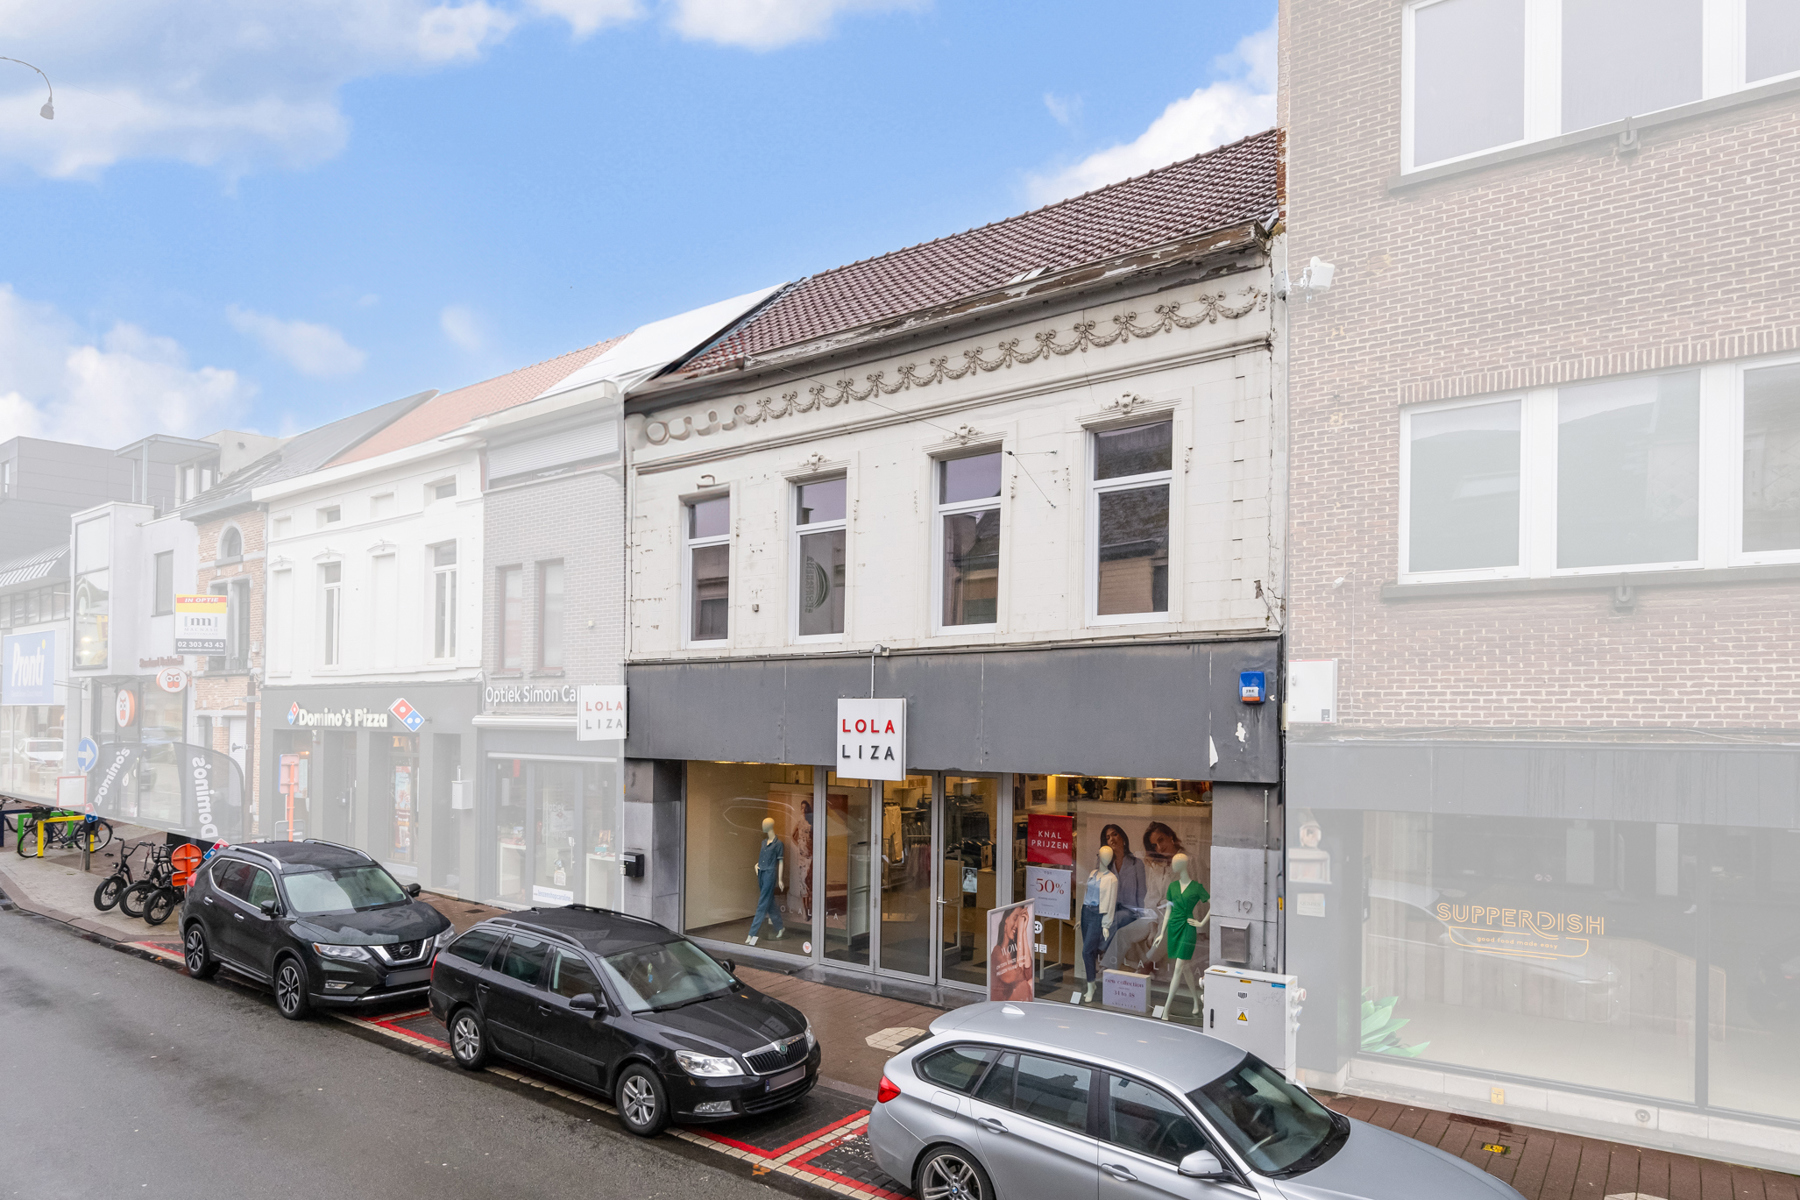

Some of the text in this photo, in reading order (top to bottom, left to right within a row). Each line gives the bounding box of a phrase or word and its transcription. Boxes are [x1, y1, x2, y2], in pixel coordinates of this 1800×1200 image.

[11, 639, 46, 687] Pronti
[485, 685, 521, 707] Optiek
[523, 684, 559, 703] Simon
[585, 701, 623, 712] LOLA
[299, 707, 388, 728] Domino's Pizza
[585, 718, 623, 730] LIZA
[842, 718, 895, 734] LOLA
[842, 744, 895, 761] LIZA
[1037, 830, 1062, 840] KNAL
[1031, 839, 1069, 850] PRIJZEN
[1235, 899, 1253, 914] 19
[1436, 902, 1605, 939] SUPPERDISH
[1497, 937, 1515, 945] food
